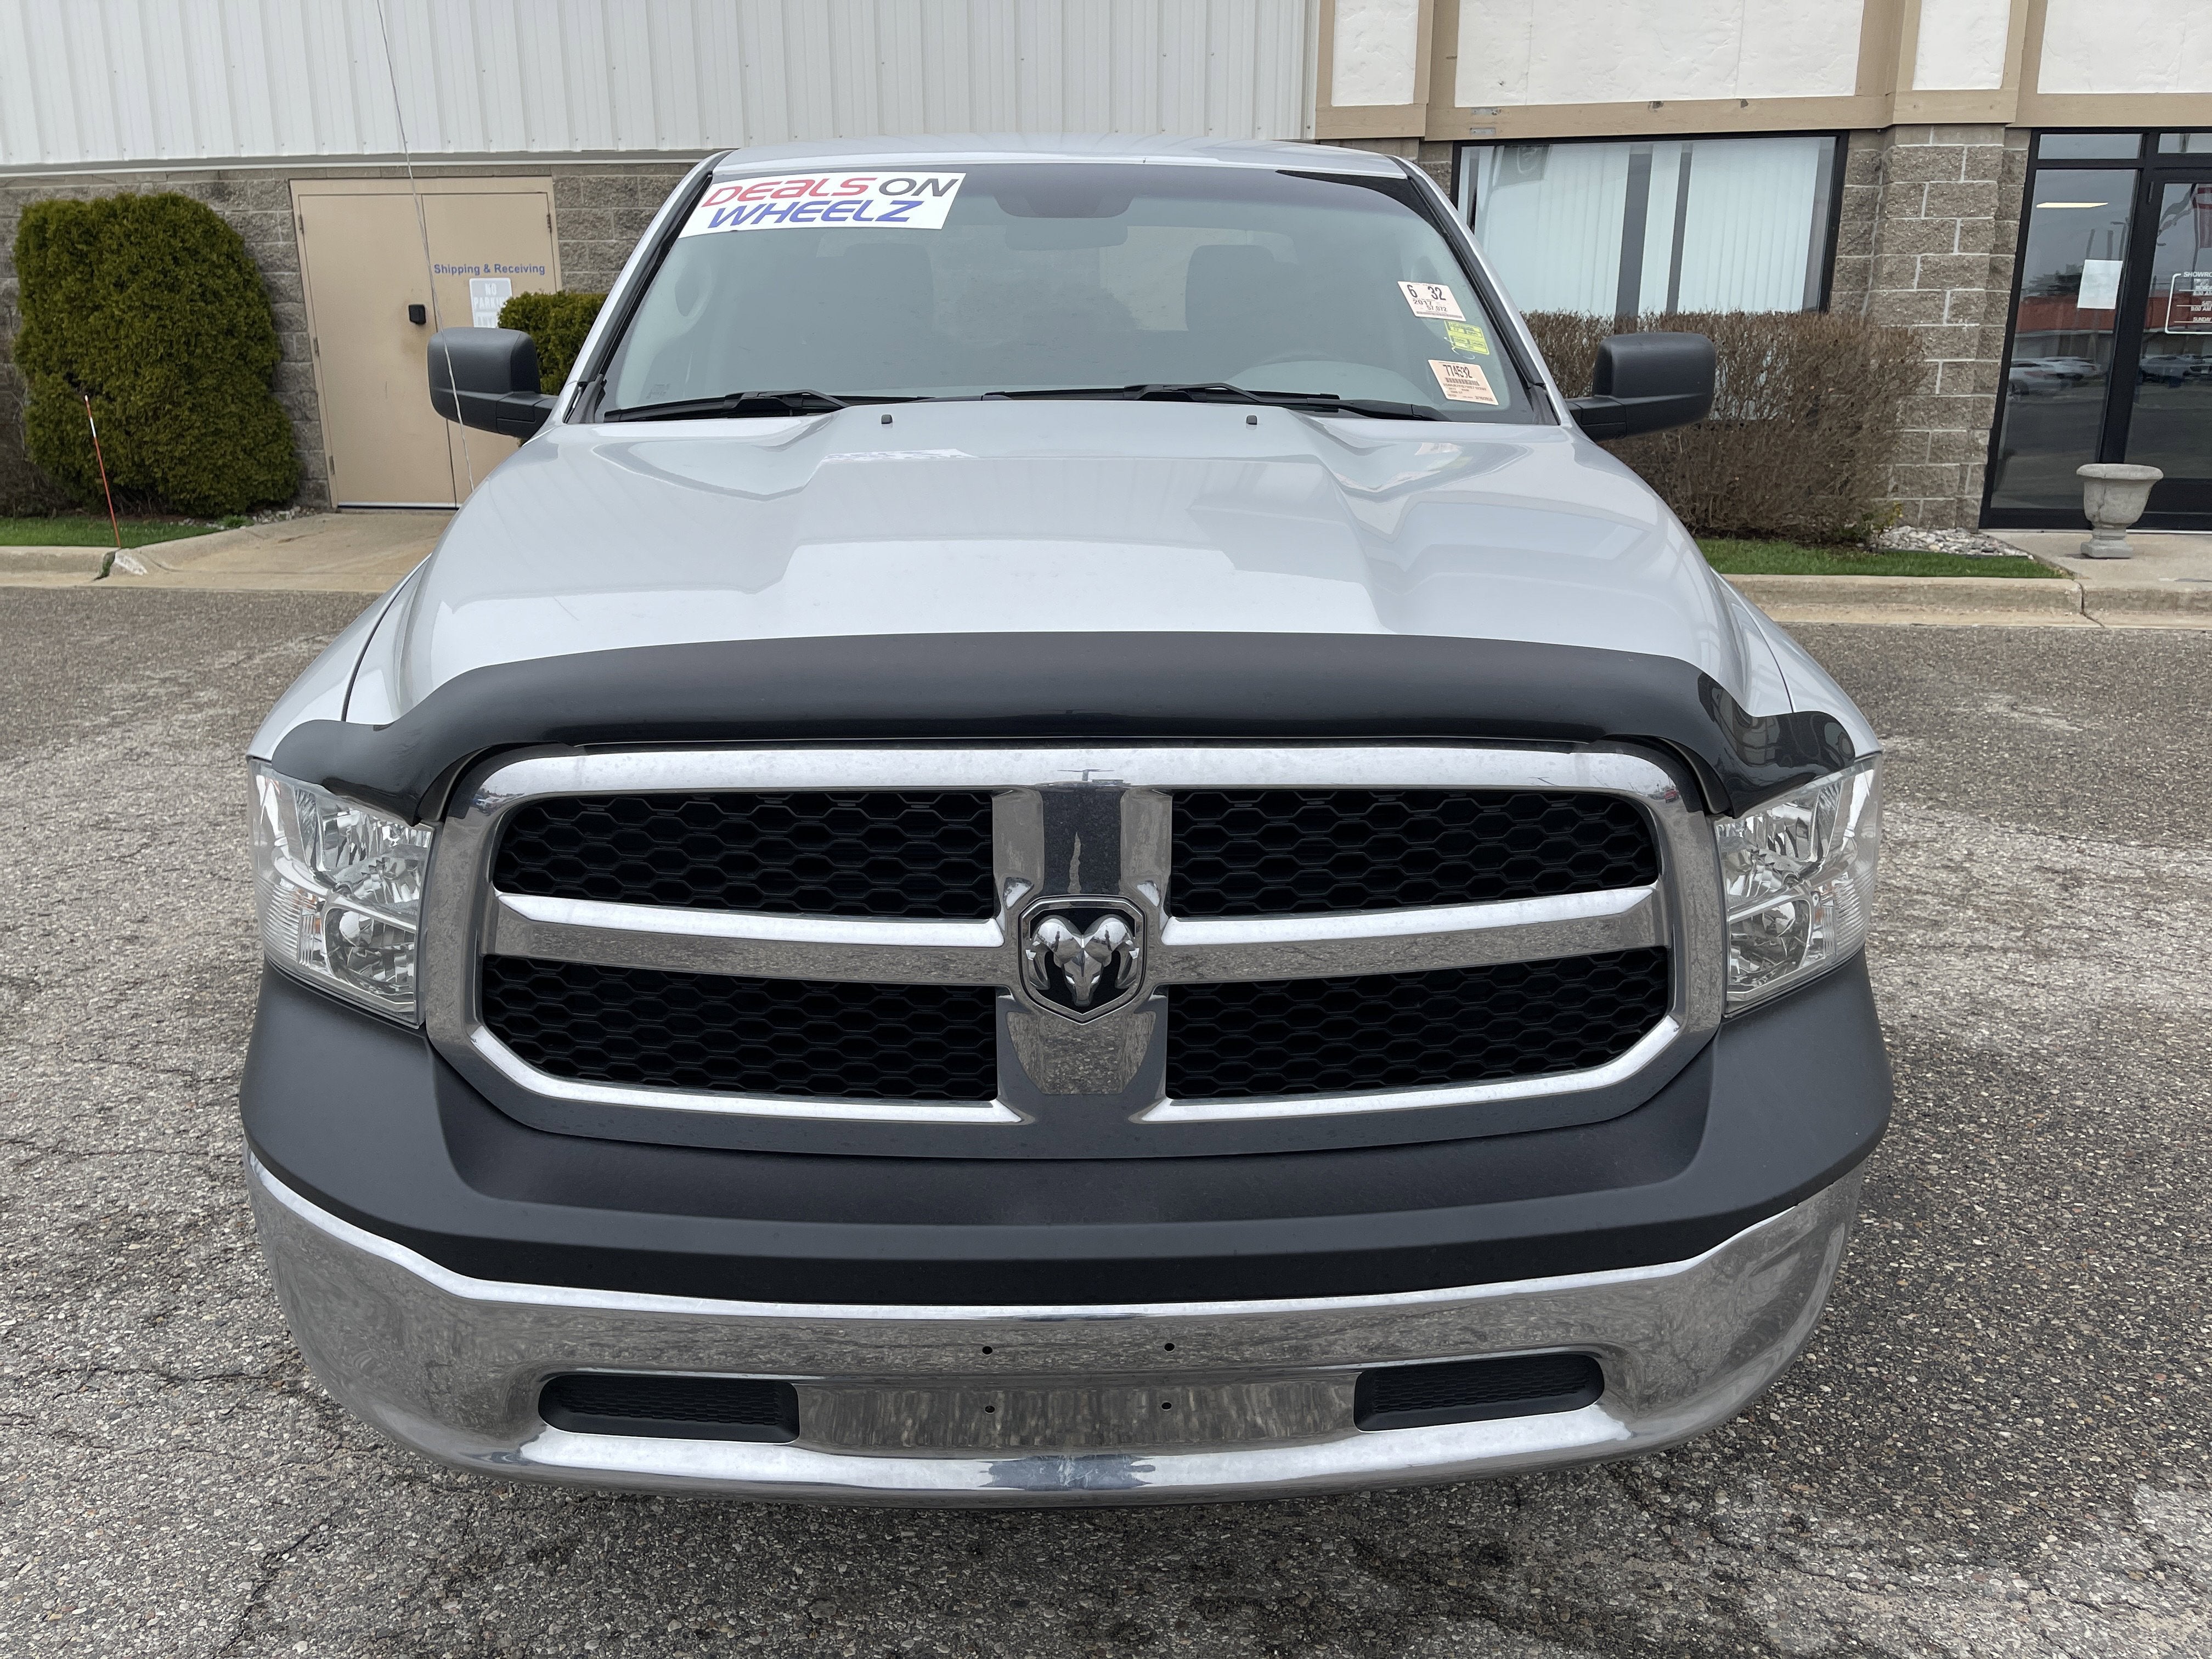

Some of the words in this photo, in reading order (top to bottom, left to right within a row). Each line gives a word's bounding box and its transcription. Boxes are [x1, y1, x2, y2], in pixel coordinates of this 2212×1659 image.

[879, 178, 959, 197] ON
[707, 200, 924, 228] WHEELZ
[434, 264, 480, 276] Shipping
[483, 264, 490, 273] &
[494, 263, 545, 275] Receiving
[485, 283, 497, 296] NO
[1407, 284, 1418, 298] 6
[1427, 286, 1446, 301] 32
[1443, 364, 1473, 379] 774532
